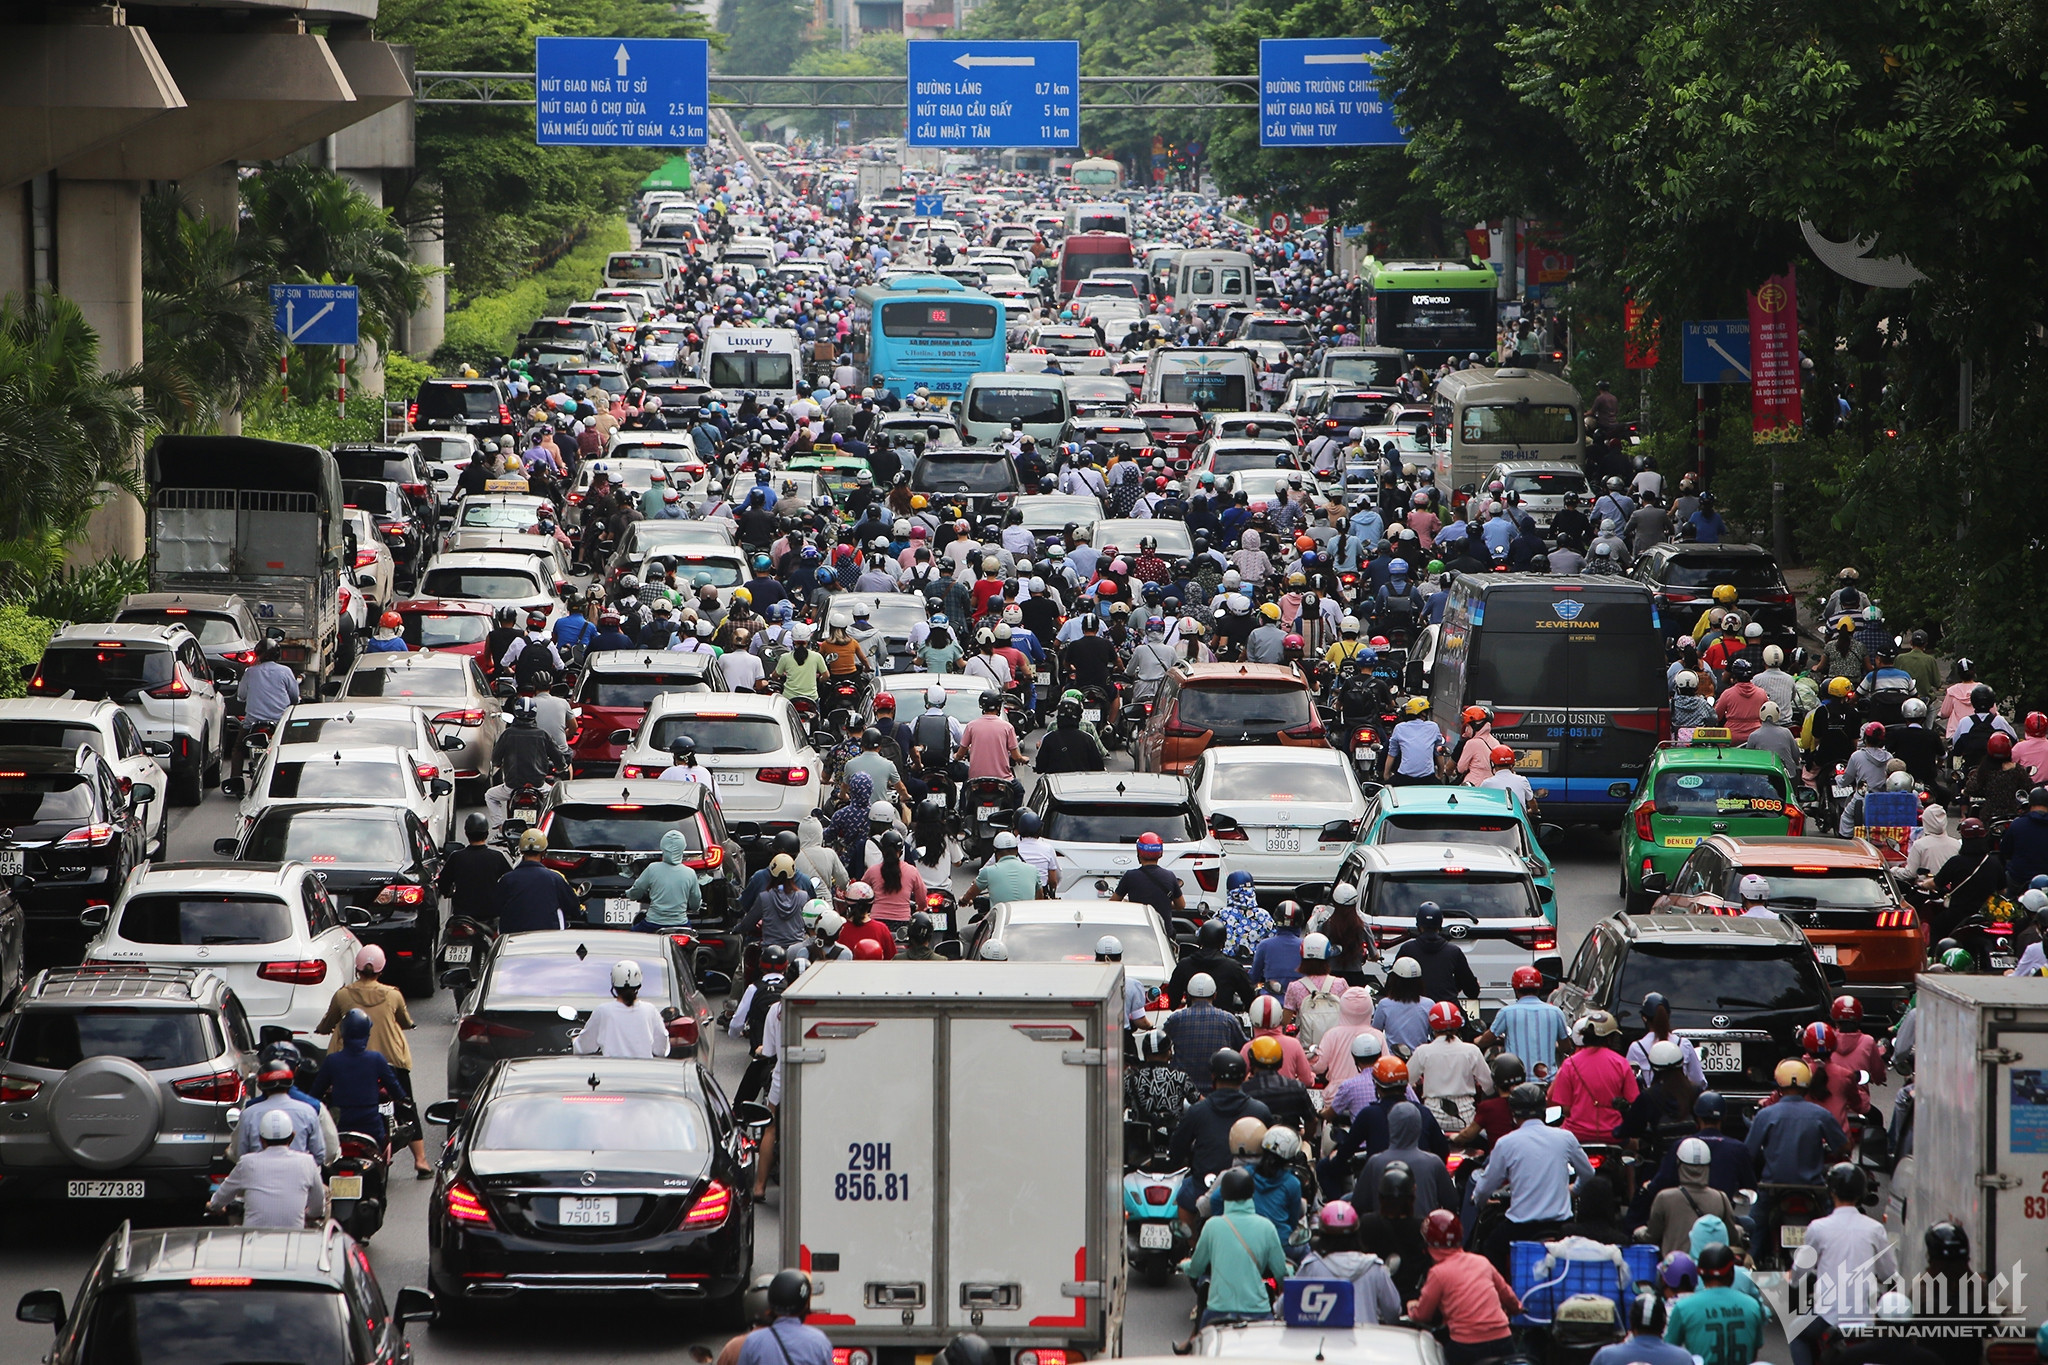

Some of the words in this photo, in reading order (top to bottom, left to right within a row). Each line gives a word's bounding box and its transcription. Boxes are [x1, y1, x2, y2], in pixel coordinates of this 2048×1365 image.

[541, 76, 561, 92] NÚT
[564, 80, 587, 92] GIAO
[591, 78, 611, 92] NGÃ
[633, 76, 648, 93] SỞ
[916, 79, 951, 95] ĐƯỜNG
[955, 79, 982, 95] LÁNG
[1053, 82, 1070, 95] km
[1265, 77, 1301, 94] ĐƯỜNG
[1305, 76, 1346, 93] TRƯỜNG
[541, 98, 561, 114] NÚT
[564, 101, 587, 114] GIAO
[591, 99, 598, 114] Ô
[601, 101, 622, 117] CHỢ
[625, 98, 646, 115] DỪA
[687, 103, 703, 115] km
[917, 101, 937, 116] NÚT
[940, 104, 963, 116] GIAO
[966, 100, 986, 116] CẦU
[989, 100, 1013, 116] GIẤY
[1044, 104, 1050, 116] 5
[1053, 104, 1070, 116] km
[1266, 99, 1287, 115] NÚT
[1289, 102, 1312, 115] GIAO
[1315, 100, 1335, 114] NGÃ
[1355, 101, 1383, 116] VỌNG
[541, 120, 562, 135] VĂN
[564, 119, 589, 135] MIẾU
[591, 119, 618, 136] QUỐC
[621, 120, 634, 136] TỬ
[637, 120, 663, 136] GIÁM
[687, 125, 703, 137] km
[917, 122, 937, 138] CẦU
[940, 124, 967, 140] NHẬT
[971, 123, 991, 138] TÂN
[1040, 126, 1051, 138] 11
[1053, 126, 1070, 138] km
[1266, 121, 1287, 137] CẦU
[1290, 121, 1314, 137] VĨNH
[1318, 124, 1337, 136] TUY
[335, 289, 355, 299] CHINH
[932, 309, 947, 322] 02
[727, 336, 773, 347] Luxury
[1464, 427, 1481, 439] 20
[1546, 727, 1604, 738] 29F-051.07
[1750, 798, 1783, 812] 1055
[1274, 829, 1292, 839] 30F
[1268, 840, 1300, 850] 390.93
[613, 899, 632, 911] 30F
[1709, 1043, 1732, 1057] 30E
[1700, 1058, 1741, 1071] 305.92
[848, 1142, 891, 1171] 29H
[69, 1182, 143, 1197] 30F-273.83
[834, 1172, 909, 1202] 856.81
[576, 1197, 600, 1211] 30G
[566, 1211, 611, 1224] 750.15
[1300, 1283, 1338, 1322] G7
